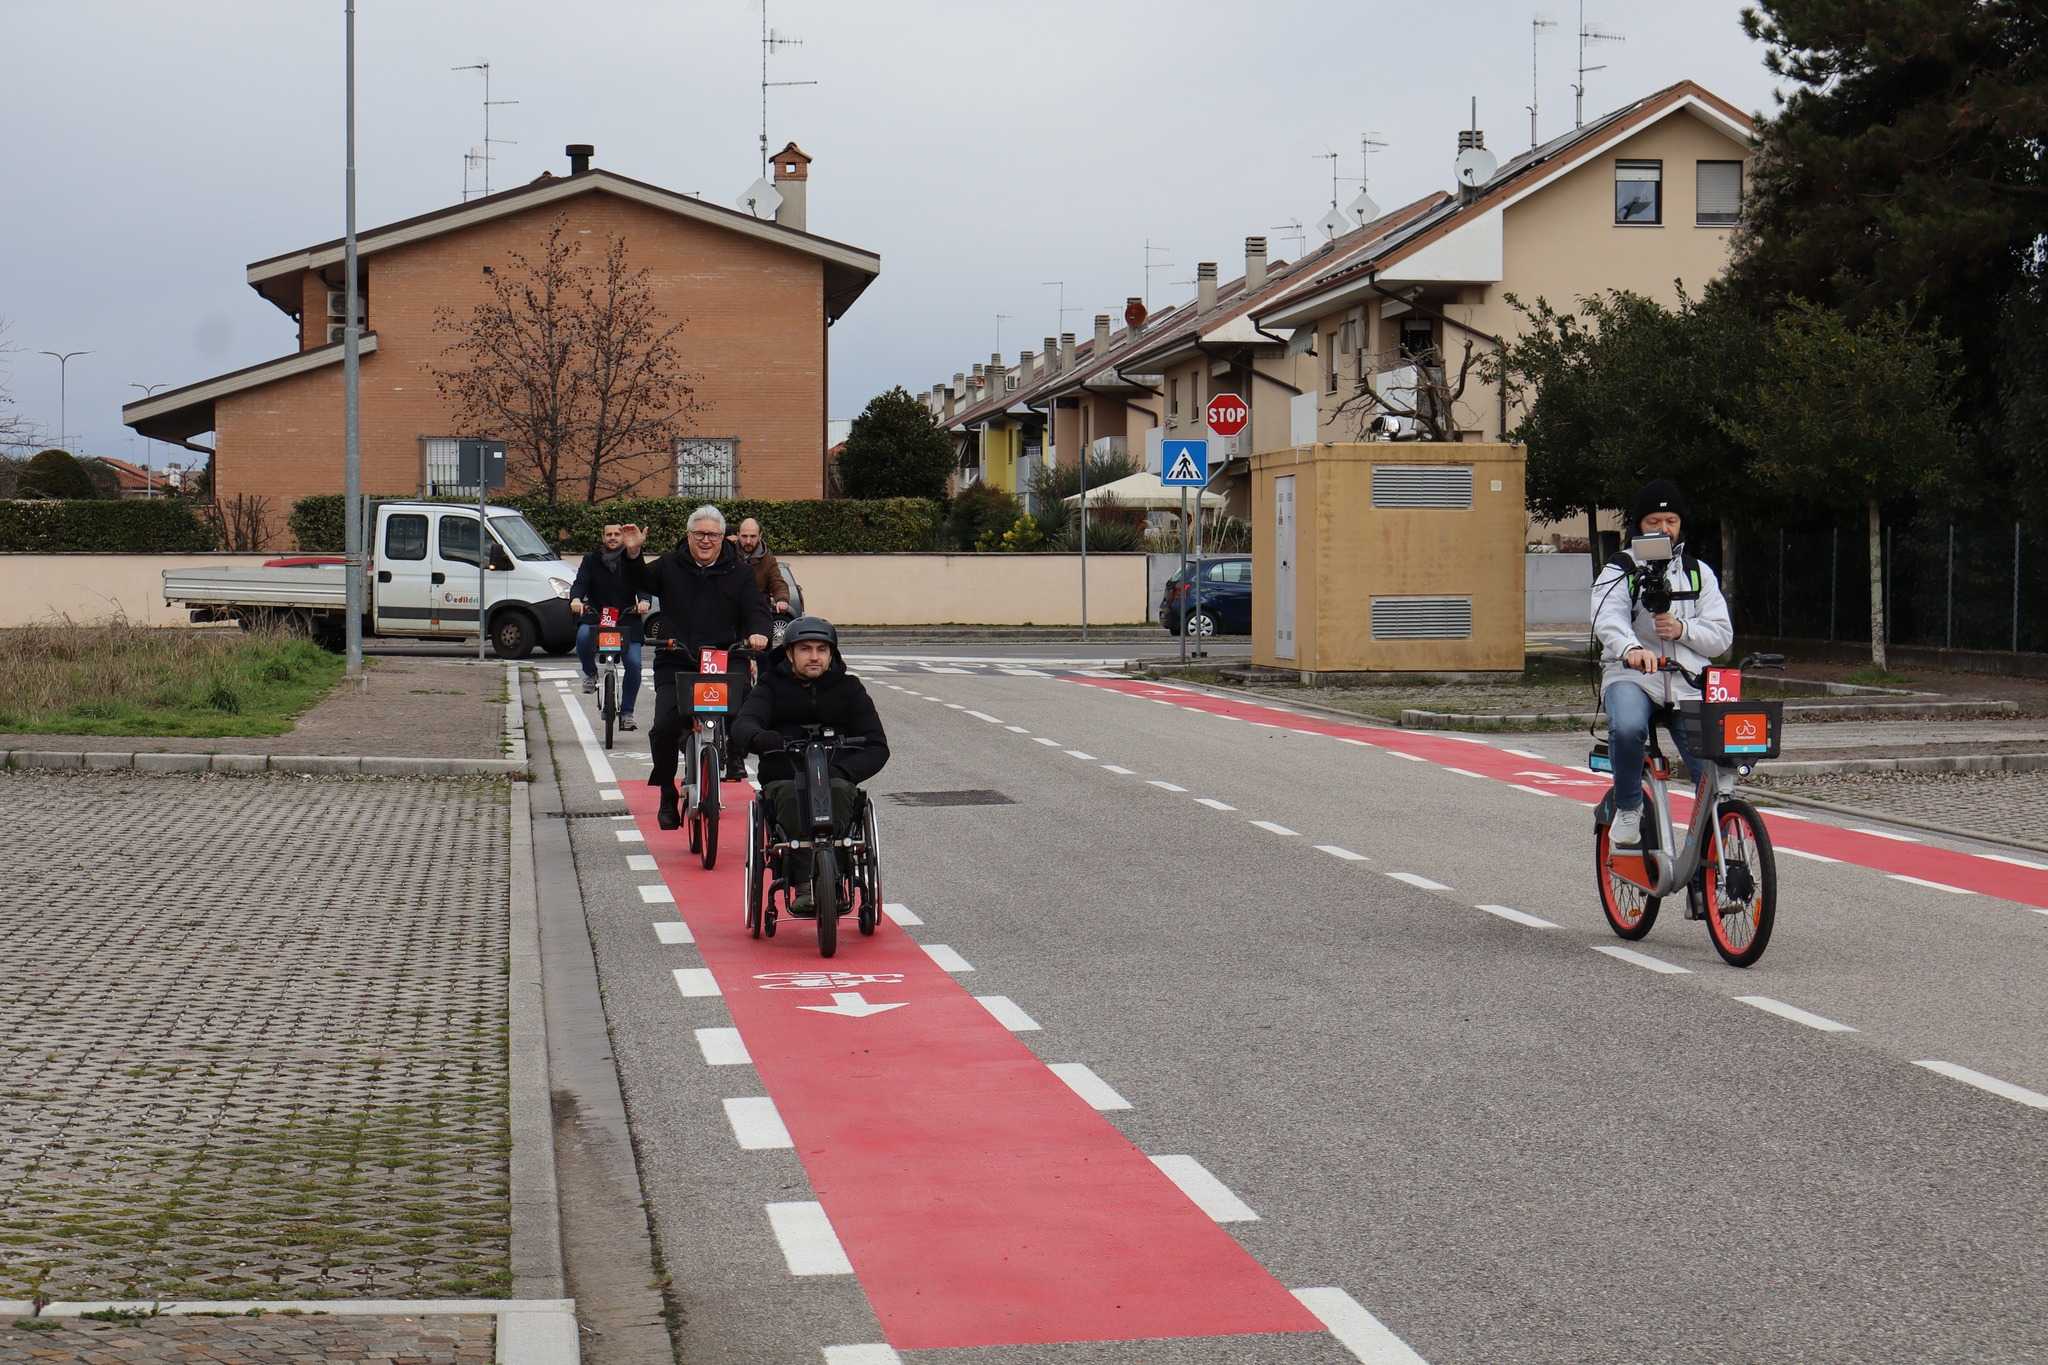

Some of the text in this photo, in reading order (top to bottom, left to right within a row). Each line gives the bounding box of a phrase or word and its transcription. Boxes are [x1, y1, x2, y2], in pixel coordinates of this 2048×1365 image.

[1209, 408, 1245, 423] STOP
[601, 614, 612, 623] 30
[702, 663, 717, 674] 30
[1708, 687, 1728, 701] 30
